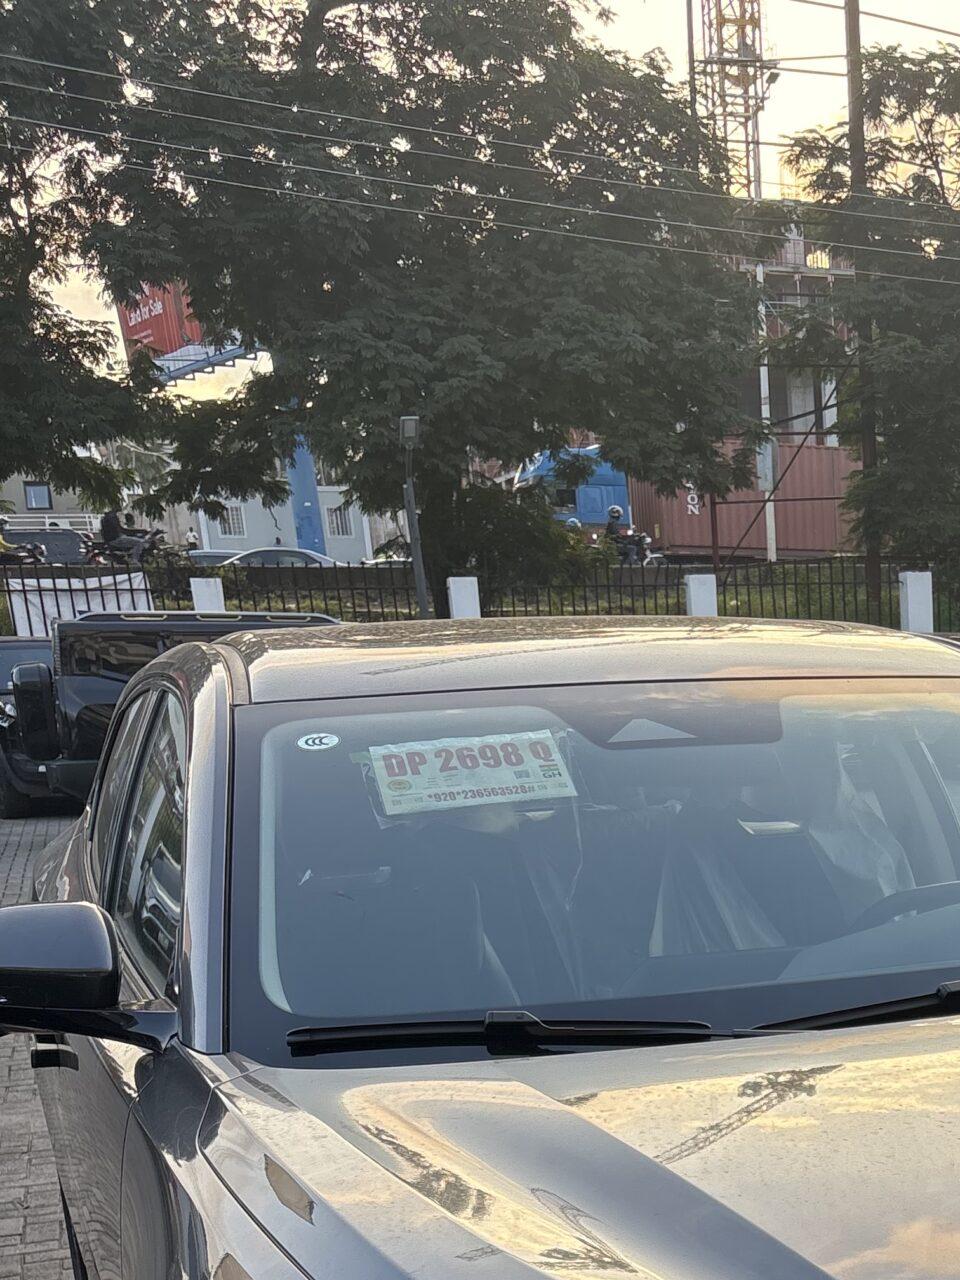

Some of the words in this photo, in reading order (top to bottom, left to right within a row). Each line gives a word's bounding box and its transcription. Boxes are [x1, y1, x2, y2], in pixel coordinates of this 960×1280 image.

[149, 297, 164, 317] Sale
[382, 751, 427, 778] DP
[434, 742, 525, 773] 2698
[528, 741, 555, 762] Q
[542, 771, 562, 779] GH
